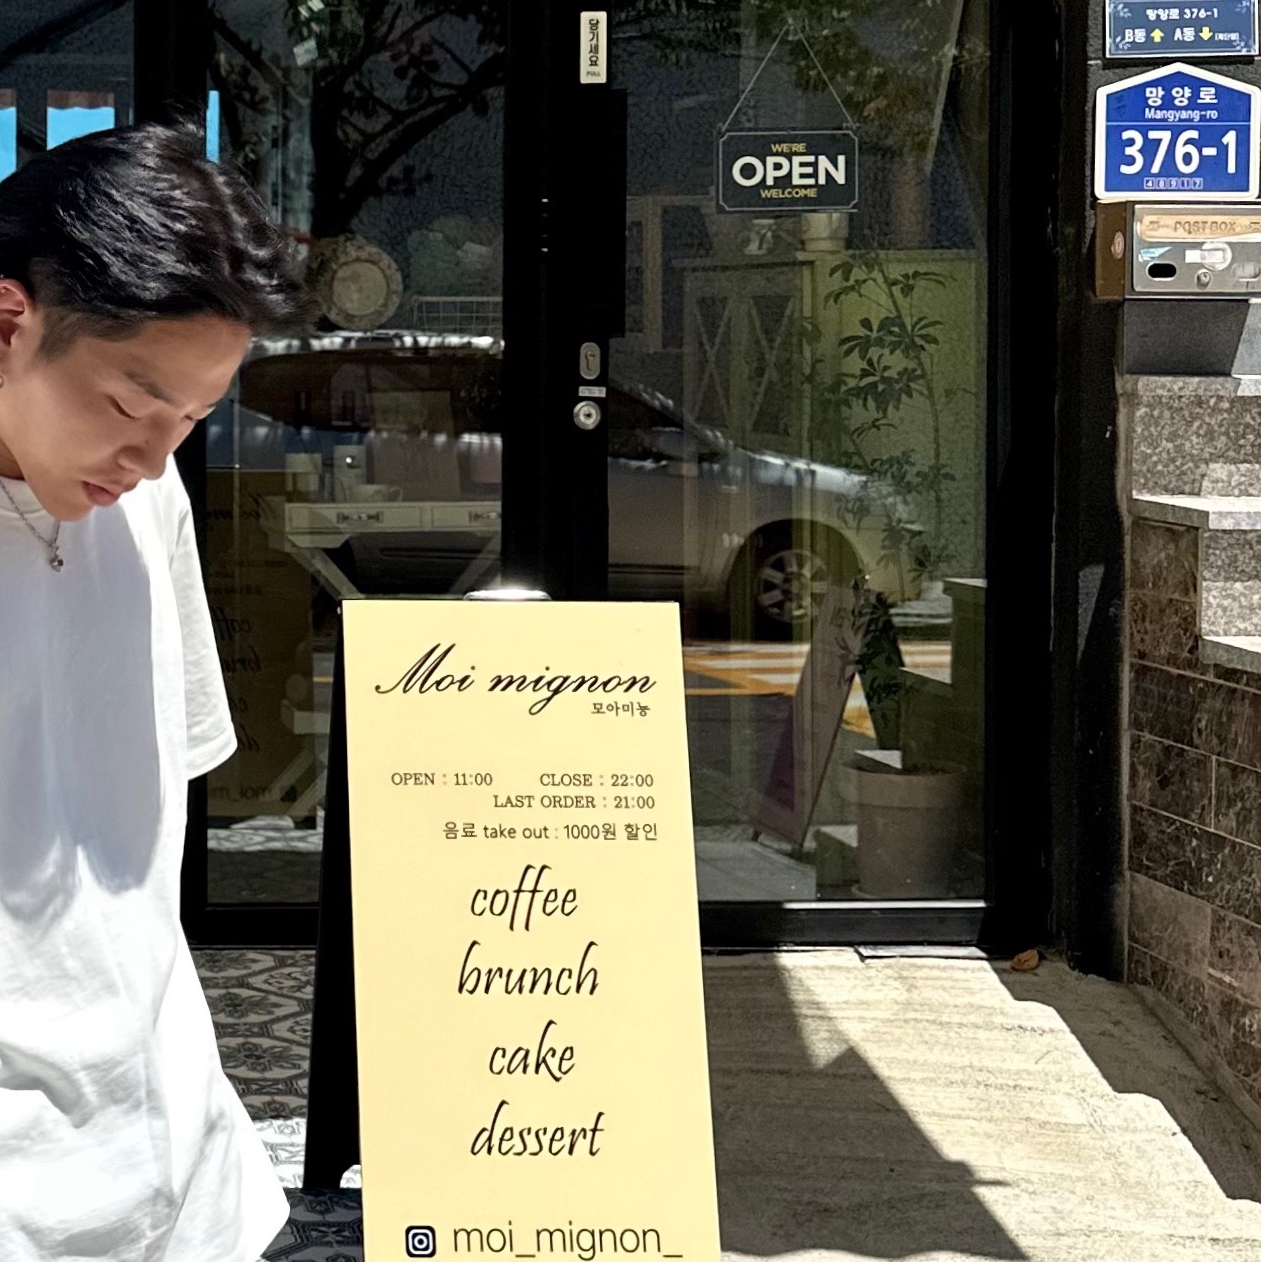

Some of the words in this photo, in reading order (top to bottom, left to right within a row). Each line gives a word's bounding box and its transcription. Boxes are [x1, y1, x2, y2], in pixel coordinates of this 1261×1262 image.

[1183, 8, 1219, 19] 376-1
[588, 18, 601, 67] 당기세요
[1124, 28, 1147, 43] B동
[1173, 27, 1196, 42] A동
[1145, 86, 1219, 106] 망양로
[1144, 107, 1219, 121] Mangyang-ro
[770, 142, 807, 153] WE'RE
[1119, 129, 1237, 175] 376-1
[731, 154, 846, 187] OPEN
[759, 187, 818, 199] WELCOME
[375, 643, 476, 694] Moi
[488, 665, 657, 717] mignon
[391, 772, 436, 786] OPEN
[453, 772, 494, 787] 11:00
[539, 773, 593, 787] CLOSE
[610, 773, 654, 788] 22:00
[493, 795, 535, 808] LAST
[540, 795, 597, 809] ORDER
[613, 795, 656, 810] 21:00
[442, 821, 478, 840] 음료
[483, 822, 517, 840] take
[522, 825, 550, 840] out
[563, 822, 617, 841] 1000원
[623, 822, 658, 842] 할인
[470, 864, 578, 931] coffee
[457, 940, 600, 996] brunch
[488, 1019, 576, 1082] cake
[469, 1099, 606, 1157] dessert
[453, 1220, 684, 1261] moi_mignon_
